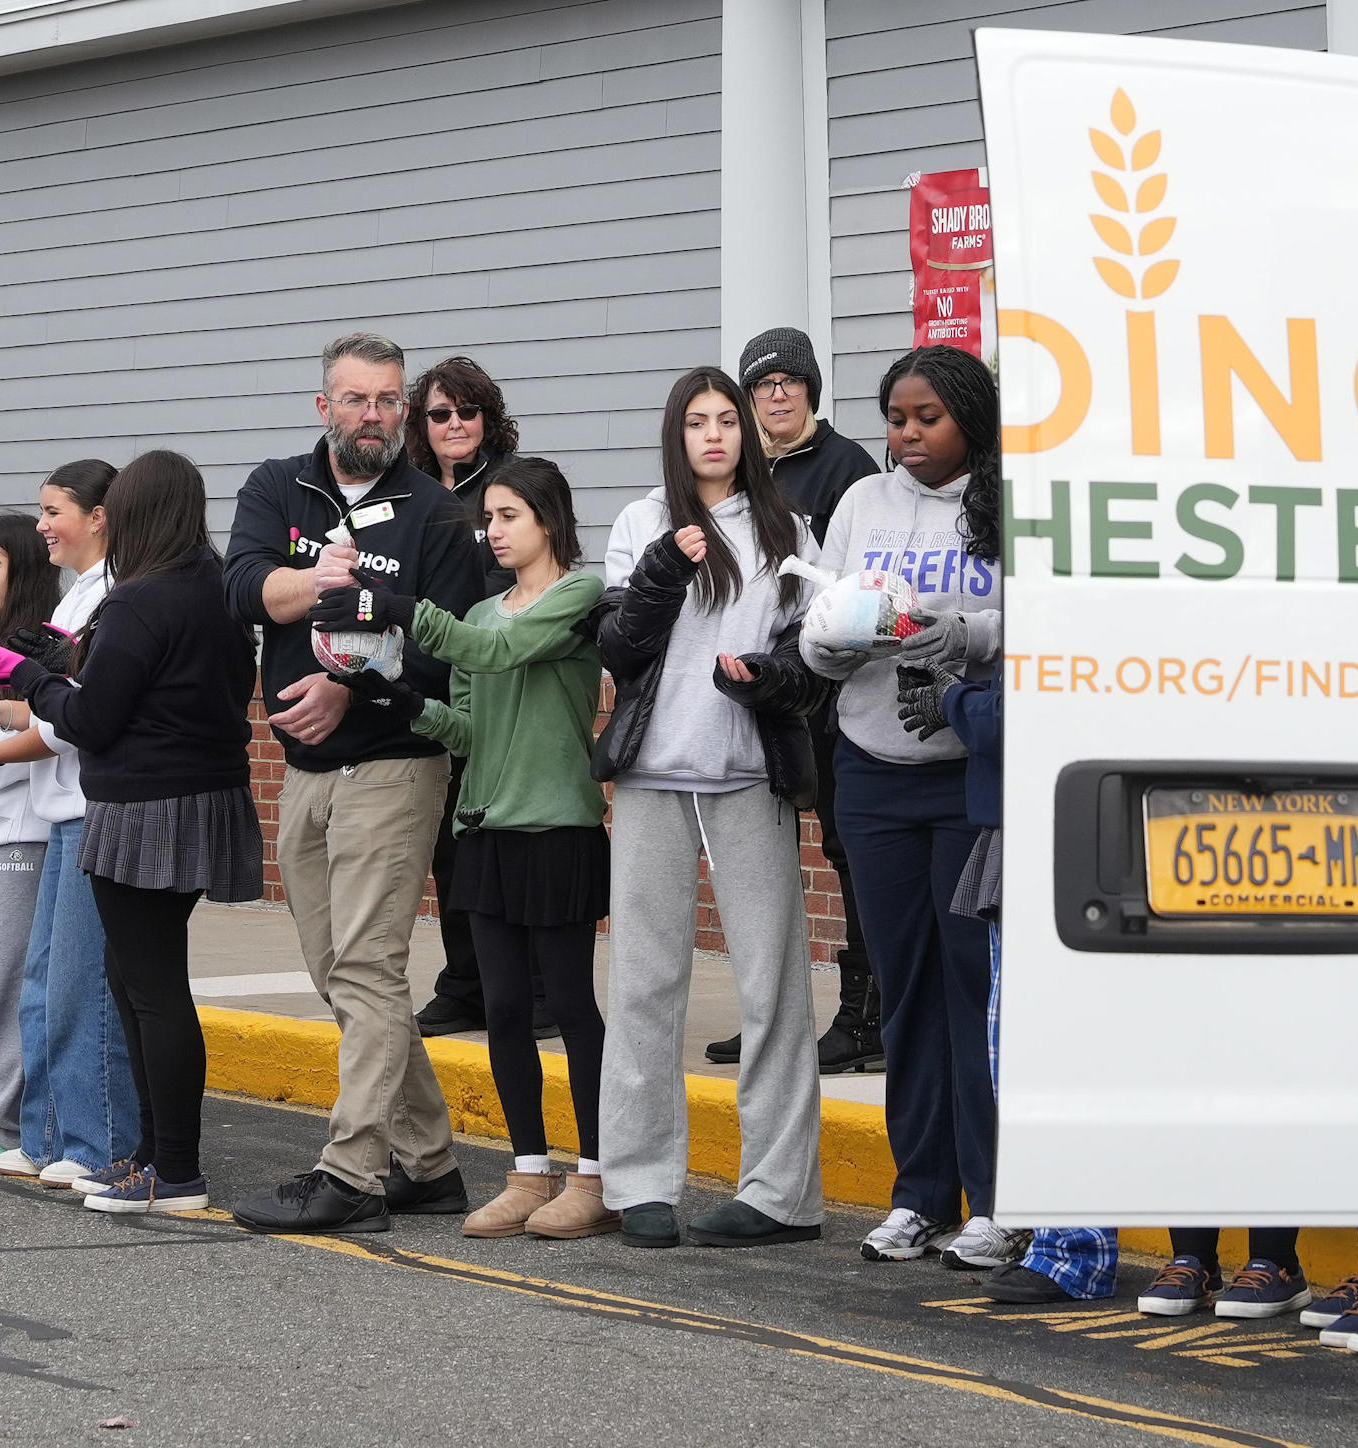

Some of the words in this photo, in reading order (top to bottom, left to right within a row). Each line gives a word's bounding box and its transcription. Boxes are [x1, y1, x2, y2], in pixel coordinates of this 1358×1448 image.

[931, 207, 970, 235] SHADY
[969, 204, 992, 231] BRO
[936, 295, 953, 318] NO
[928, 327, 968, 339] ANTIBIOTICS
[1208, 794, 1266, 812] NEW
[1272, 794, 1335, 813] YORK
[1209, 894, 1340, 908] COMMERCIAL
